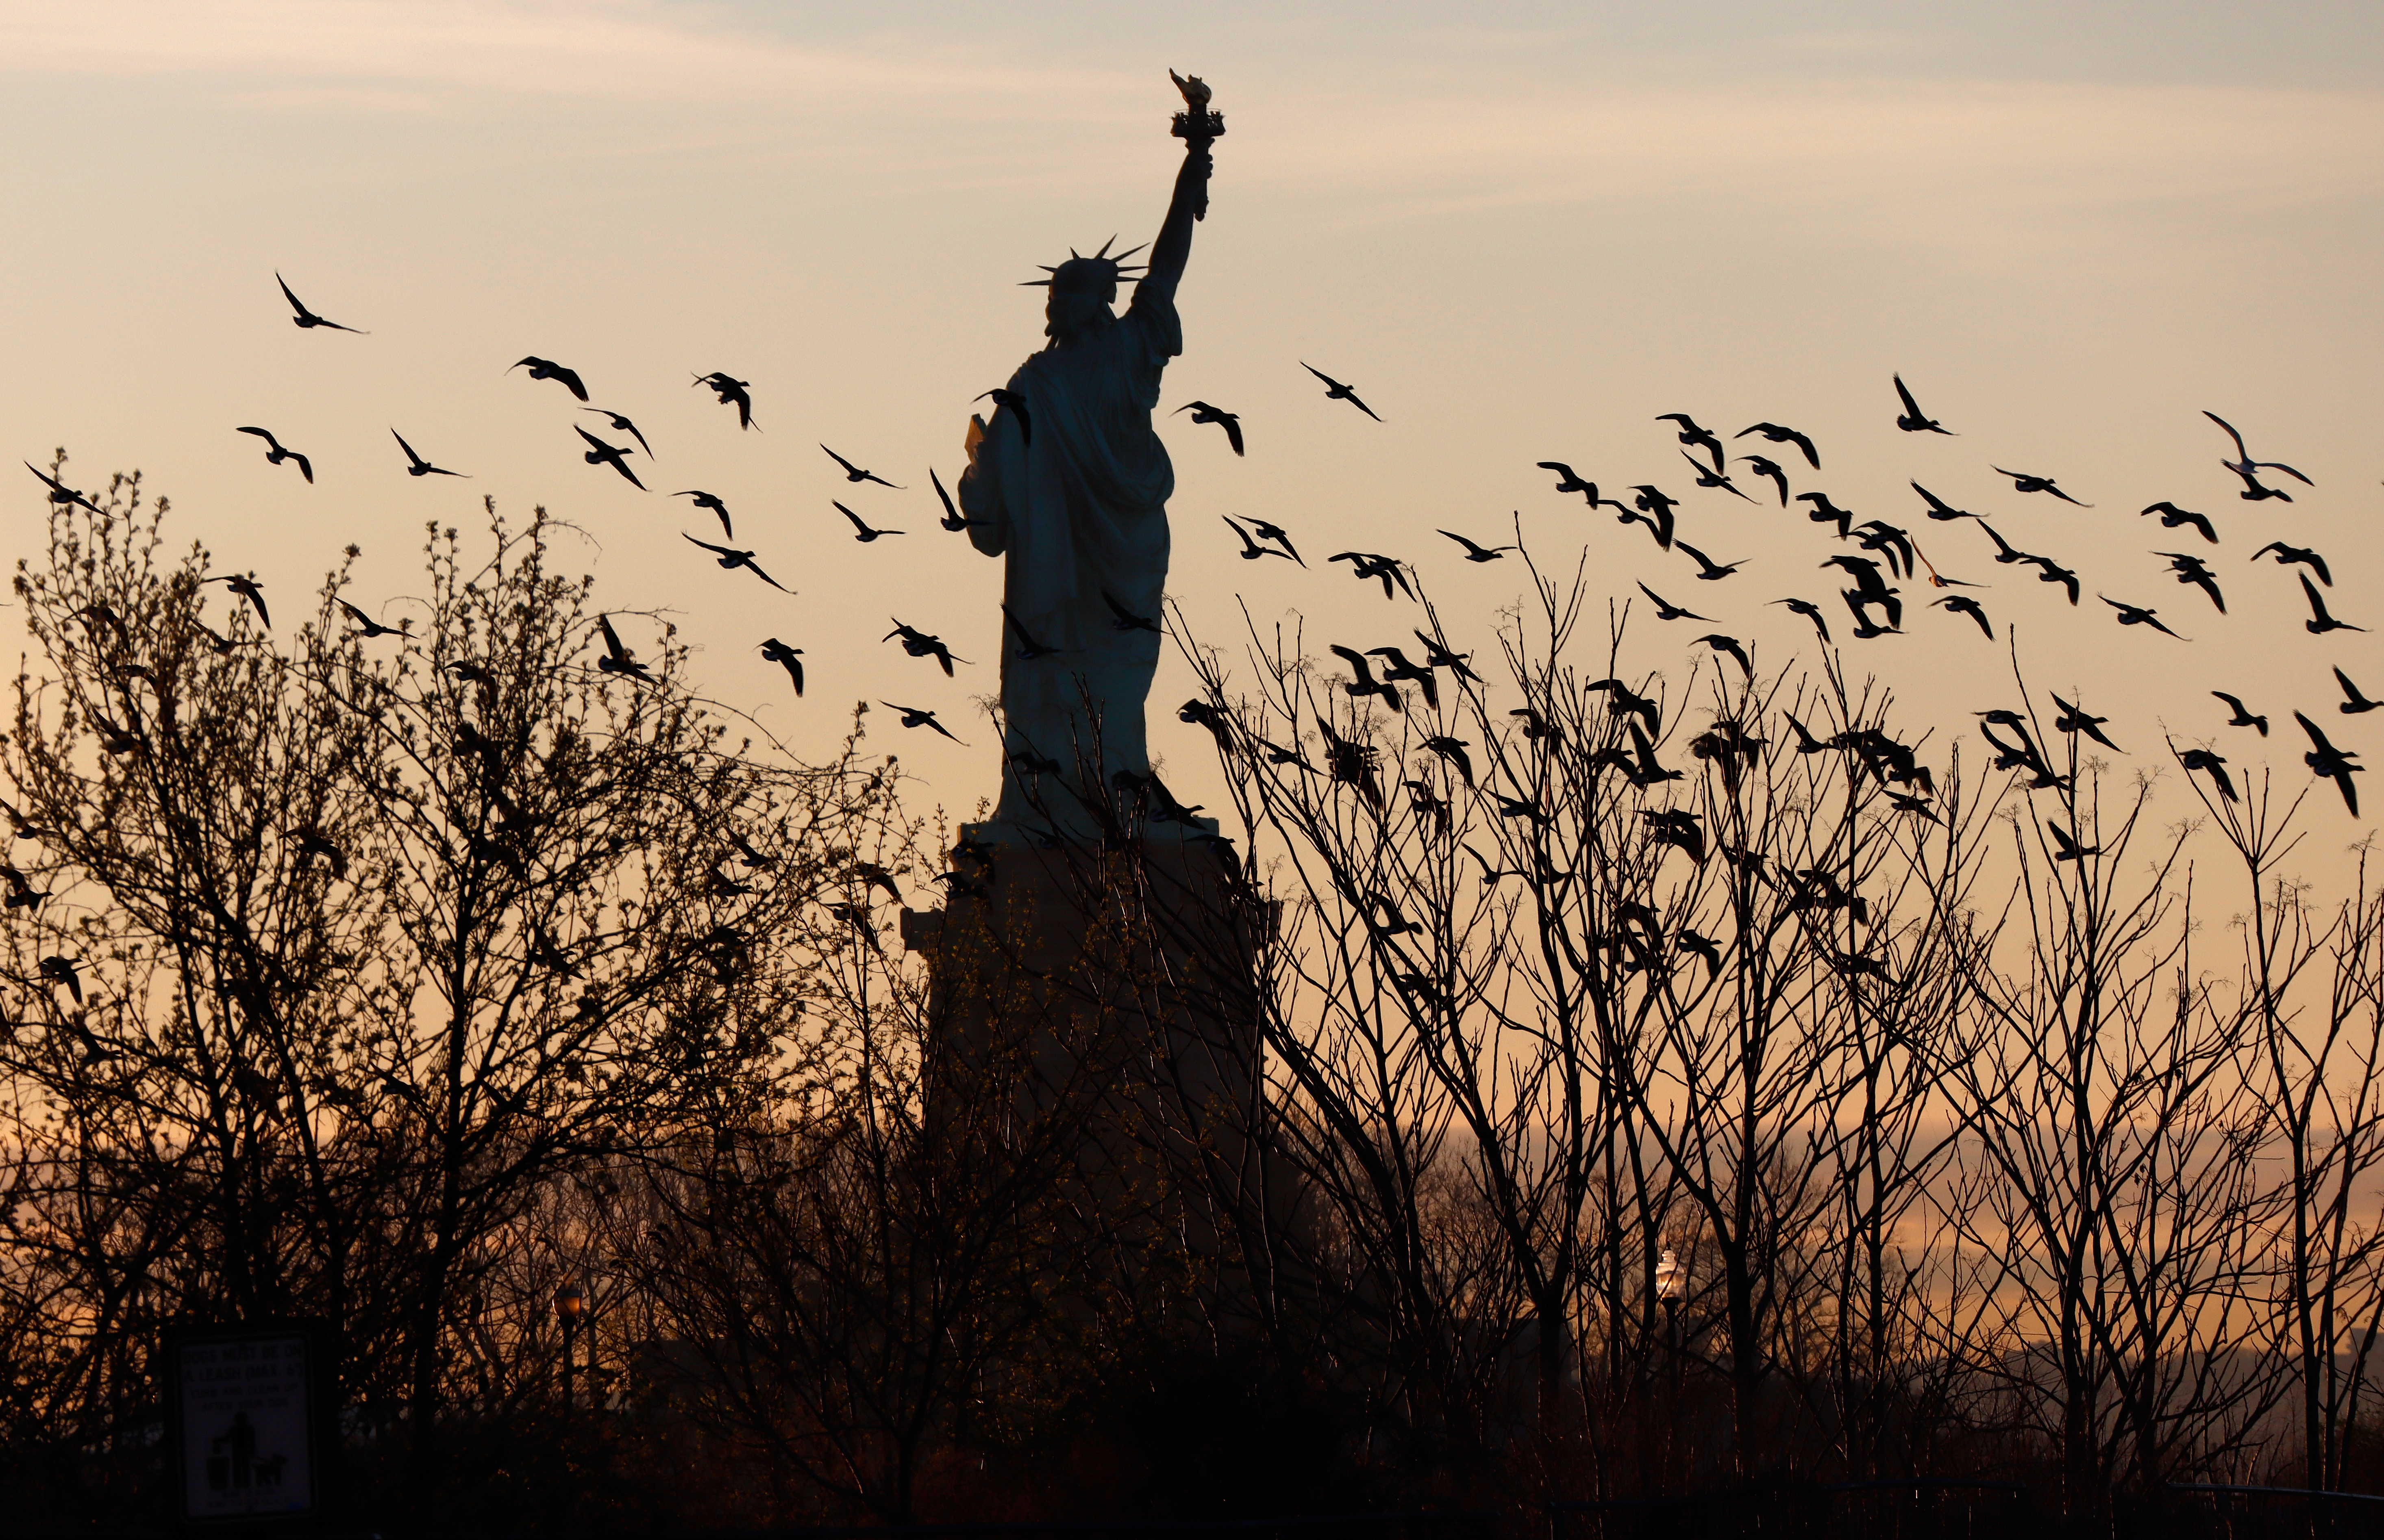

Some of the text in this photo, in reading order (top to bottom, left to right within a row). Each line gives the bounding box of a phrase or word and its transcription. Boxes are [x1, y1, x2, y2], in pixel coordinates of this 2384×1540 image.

[183, 1344, 302, 1365] DOGS MUST BE ON
[185, 1370, 194, 1382] A
[199, 1367, 241, 1381] LEASH
[191, 1383, 297, 1398] CURB AND CLEAN UP
[202, 1398, 288, 1411] AFTER YOUR DOG
